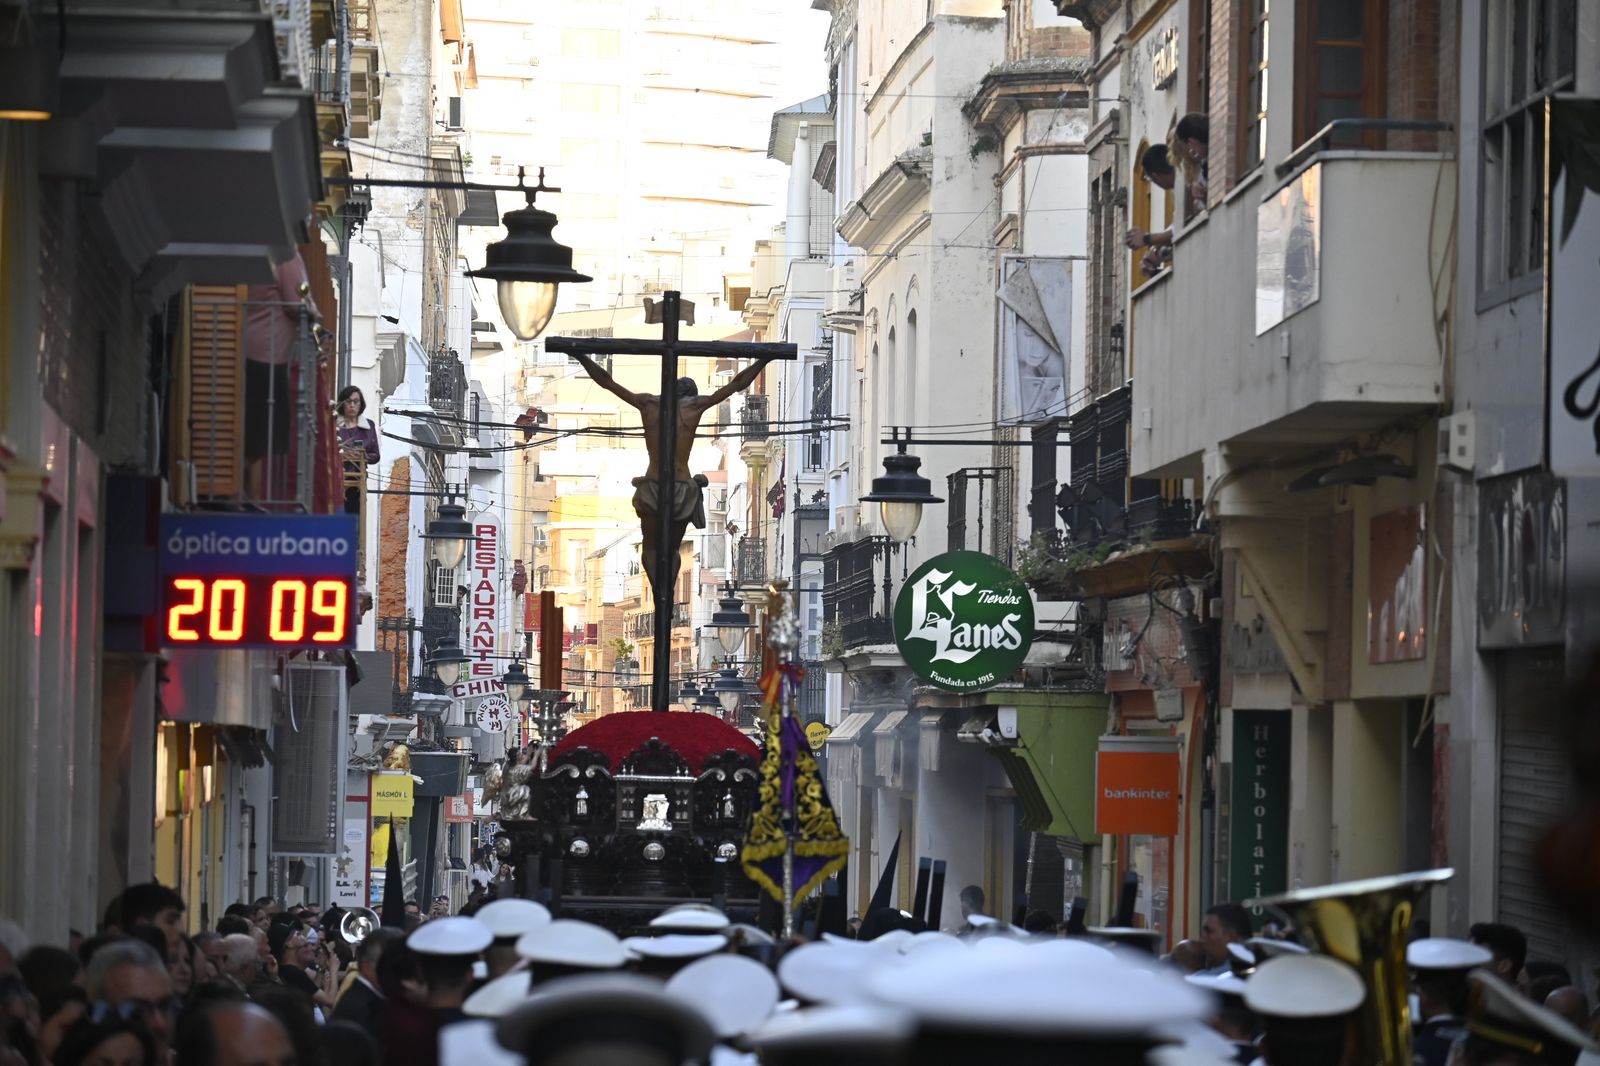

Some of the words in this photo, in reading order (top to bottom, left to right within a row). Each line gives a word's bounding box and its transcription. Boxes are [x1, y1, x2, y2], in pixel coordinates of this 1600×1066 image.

[167, 528, 250, 559] óptica
[256, 531, 348, 557] urbano
[167, 579, 246, 642] 20
[269, 580, 348, 643] 09
[473, 524, 497, 676] RESTAURANTE
[977, 588, 1022, 605] Tiendas
[452, 677, 505, 698] CHIN
[929, 671, 965, 687] Fundada
[978, 672, 995, 686] 1915
[1252, 725, 1269, 917] Herbolario
